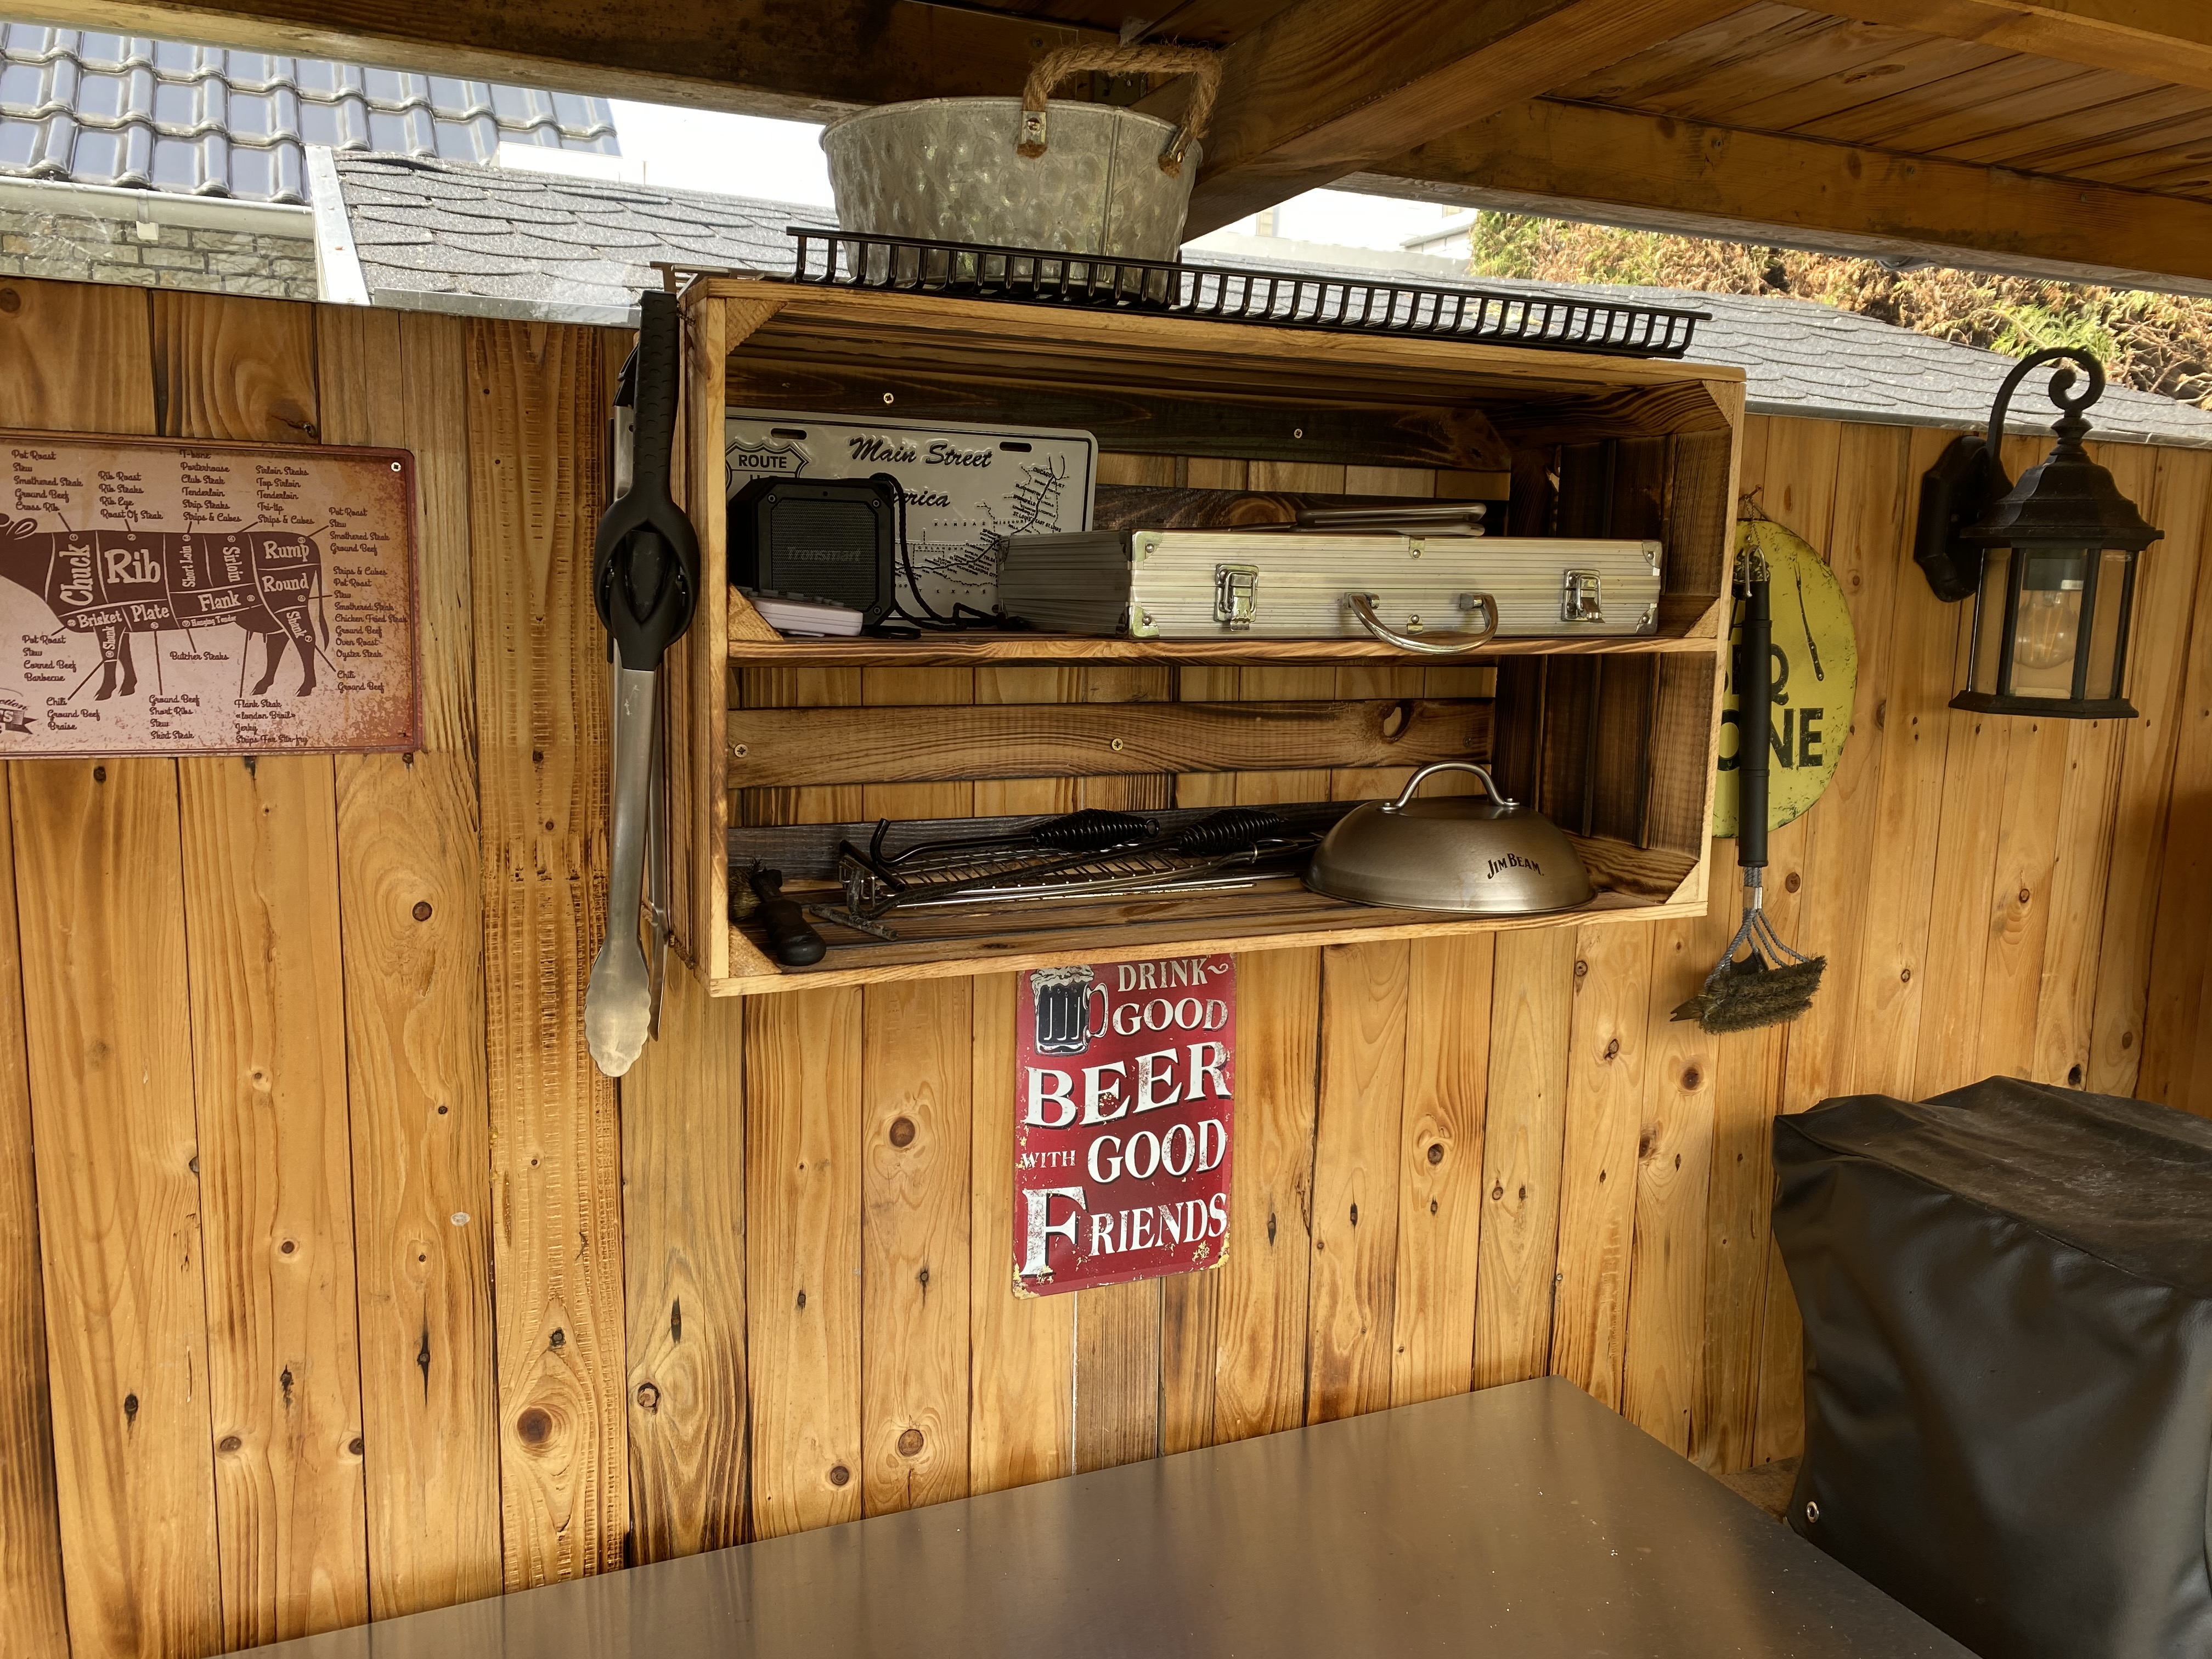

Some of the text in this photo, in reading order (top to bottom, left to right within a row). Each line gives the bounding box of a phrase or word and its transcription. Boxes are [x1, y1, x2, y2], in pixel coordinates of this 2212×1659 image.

[12, 449, 56, 460] Pot Roast
[180, 450, 211, 459] T-bone
[849, 437, 992, 467] Main Street
[13, 462, 32, 472] Stew
[180, 462, 230, 472] Porterhouse
[738, 454, 787, 468] ROUTE
[98, 471, 142, 481] Rib Roast
[256, 465, 309, 476] Sirloin Steaks
[1033, 467, 1052, 478] CHICAGO
[14, 475, 83, 486] Smothered Steak
[182, 474, 225, 484] Club Steak
[256, 477, 301, 490] Top Sirloin
[99, 483, 144, 494] Rib Steaks
[182, 487, 225, 496] Tenderloin
[257, 490, 298, 499] Tenderloin
[15, 488, 69, 503] Ground Beef
[894, 490, 951, 507] erica
[16, 501, 60, 512] Cross Rib
[100, 496, 134, 510] Rib Eye
[183, 499, 230, 512] Strip Steaks
[100, 509, 163, 522] Roast Of Steak
[183, 512, 242, 524] Strips & Cubes
[329, 507, 368, 517] Pot Roast
[258, 514, 315, 527] Strips & Cubes
[329, 519, 346, 527] Stew
[330, 531, 390, 540] Smothered Steak
[263, 540, 309, 562] Rump
[330, 543, 377, 556] Ground Beef
[104, 549, 161, 584] Rib
[179, 545, 196, 588] Short Loin
[223, 546, 243, 583] Sirloin
[59, 544, 93, 606] Chuck
[334, 566, 387, 578] Strips & Cubes
[262, 573, 309, 592] Round
[349, 578, 372, 588] Roast
[198, 590, 241, 612] Flank
[334, 602, 394, 611] Smothered Steak
[130, 604, 170, 622] Plate
[335, 613, 364, 622] Chicken
[365, 614, 387, 622] Fried
[77, 611, 122, 628] Brisket
[286, 611, 308, 639] Shank
[336, 625, 382, 638] Ground Beef
[22, 635, 66, 645] Pot Roast
[102, 626, 115, 650] Shank
[356, 637, 379, 647] Roast
[22, 648, 42, 656] Stew
[170, 651, 229, 660] Butcher Steaks
[336, 650, 361, 661] Oyster
[24, 660, 76, 673] Corned Beef
[24, 673, 65, 681] Barbecue
[338, 682, 385, 693] Ground Beef
[149, 694, 200, 707] Ground Beef
[234, 699, 282, 708] Flank Steak
[47, 709, 100, 721] Ground Beef
[149, 707, 194, 716] Short Ribs
[48, 721, 77, 730] Braise
[150, 719, 170, 727] Stew
[235, 723, 258, 735] Jerky
[151, 730, 194, 739] Skirt Steak
[236, 735, 308, 747] Strips For Stir-fry
[1487, 857, 1508, 879] JIM
[1118, 957, 1208, 992] DRINK
[1112, 997, 1229, 1036] GOOD
[1024, 1041, 1232, 1128] BEER
[1020, 1119, 1227, 1183] WITH GOOD
[1019, 1186, 1228, 1278] FRIENDS
